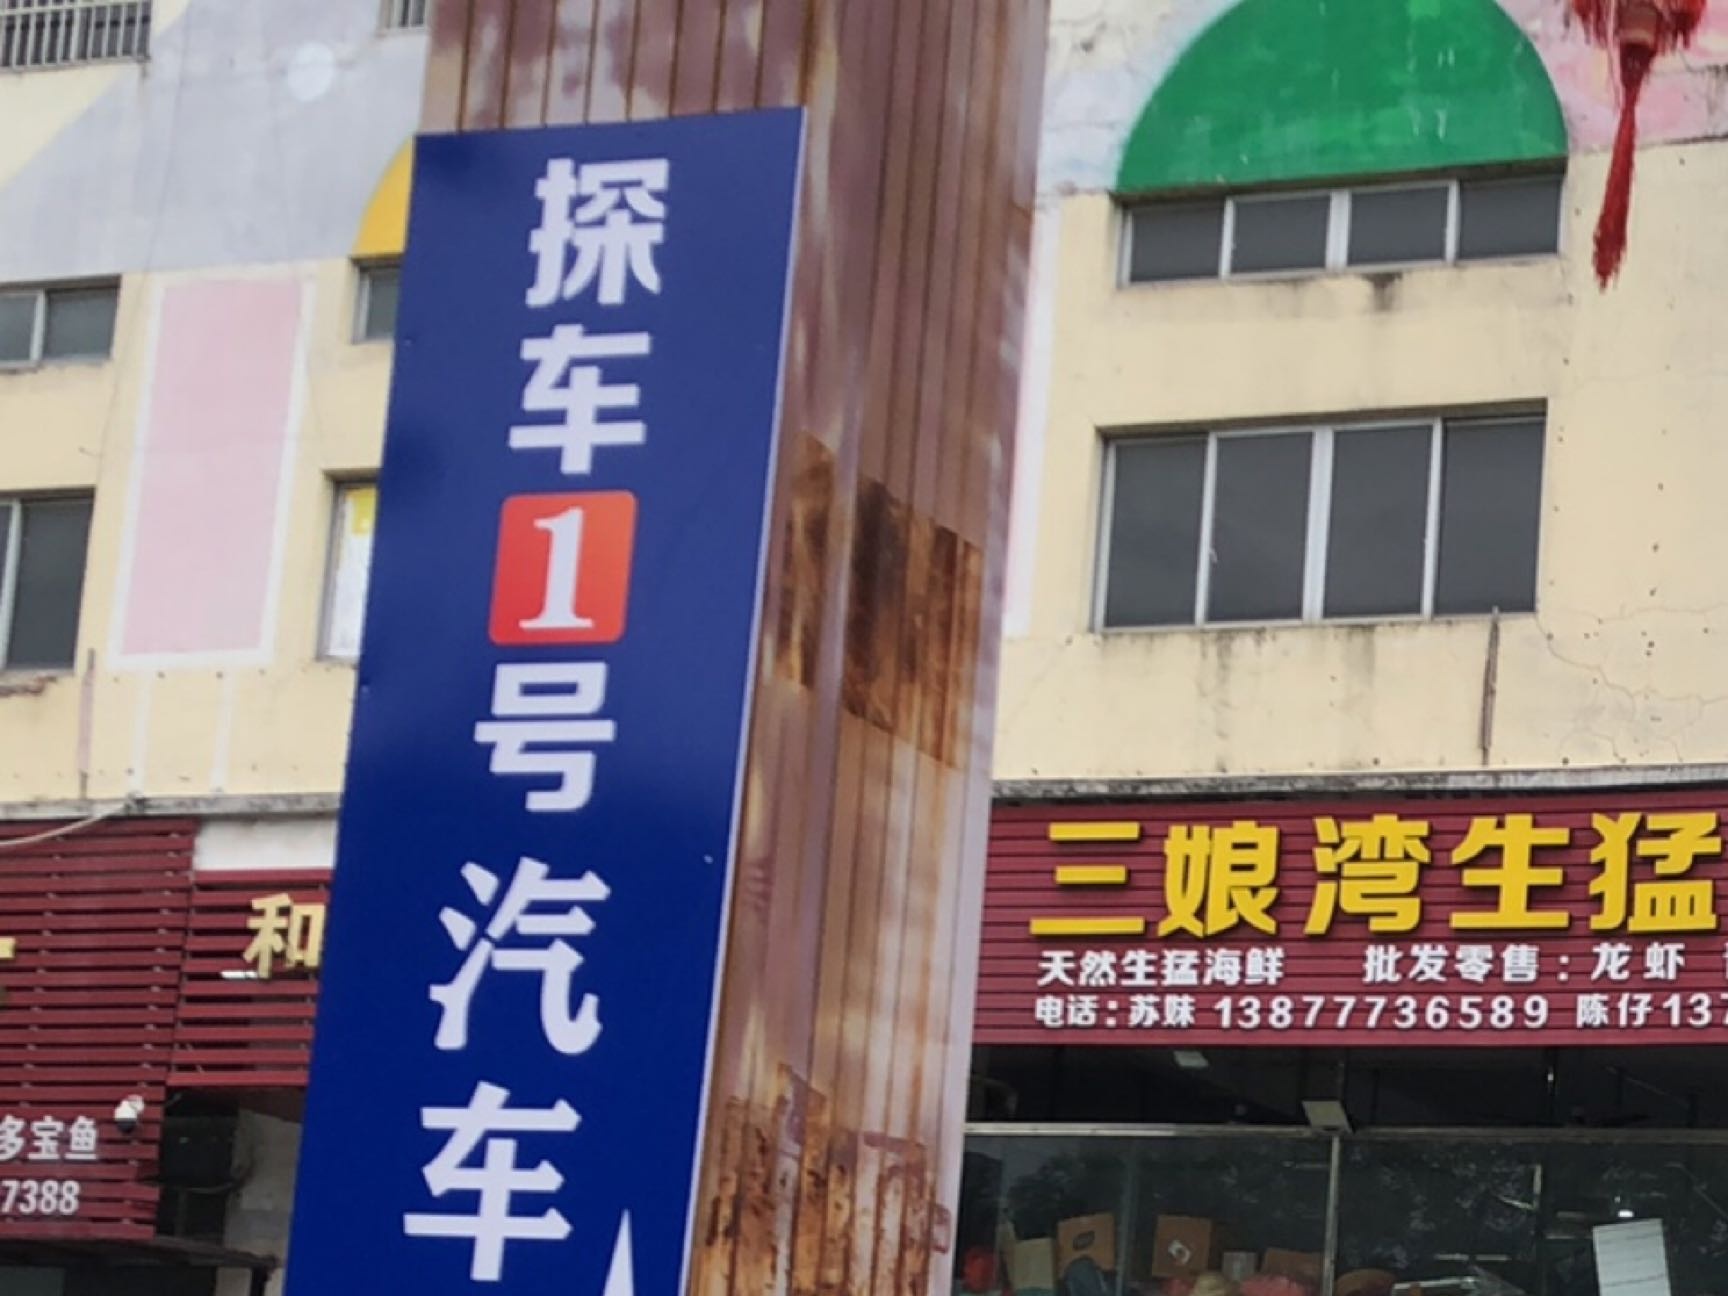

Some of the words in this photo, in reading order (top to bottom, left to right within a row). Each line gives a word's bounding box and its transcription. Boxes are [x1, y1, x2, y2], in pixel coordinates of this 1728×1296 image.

[1037, 948, 1285, 986] 天然生猛海鲜
[1212, 995, 1548, 1030] 13877736589
[0, 1115, 97, 1161] 多宝鱼
[0, 1179, 80, 1215] 7388
